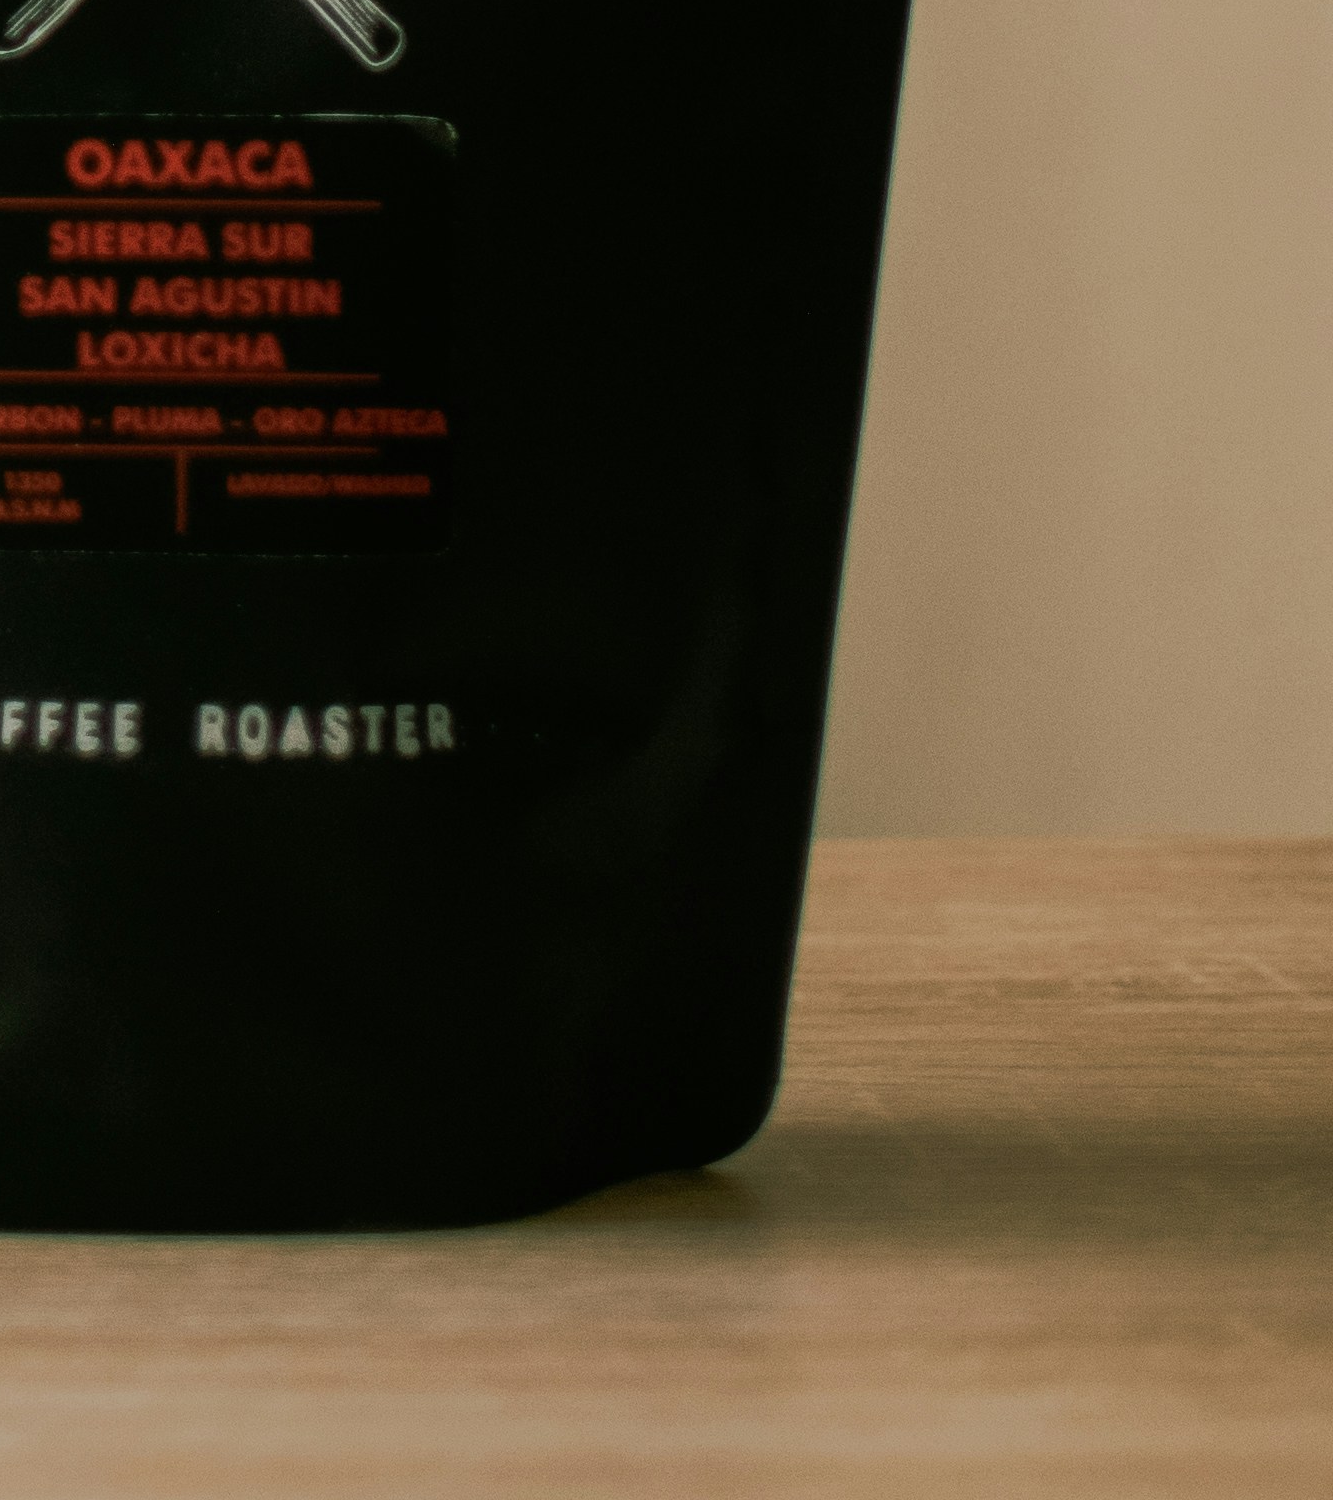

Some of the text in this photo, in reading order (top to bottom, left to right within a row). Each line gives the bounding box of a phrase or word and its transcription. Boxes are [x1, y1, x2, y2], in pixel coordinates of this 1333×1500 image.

[65, 138, 313, 189] OAXACA
[49, 220, 313, 262] SIERRA SUR
[19, 275, 342, 318] SAN AGUSTIN
[77, 330, 285, 369] LOXICHA
[111, 405, 223, 437] PLUMA
[252, 406, 326, 437] ORO
[331, 407, 448, 438] AZTECA
[196, 702, 454, 759] ROASTER
